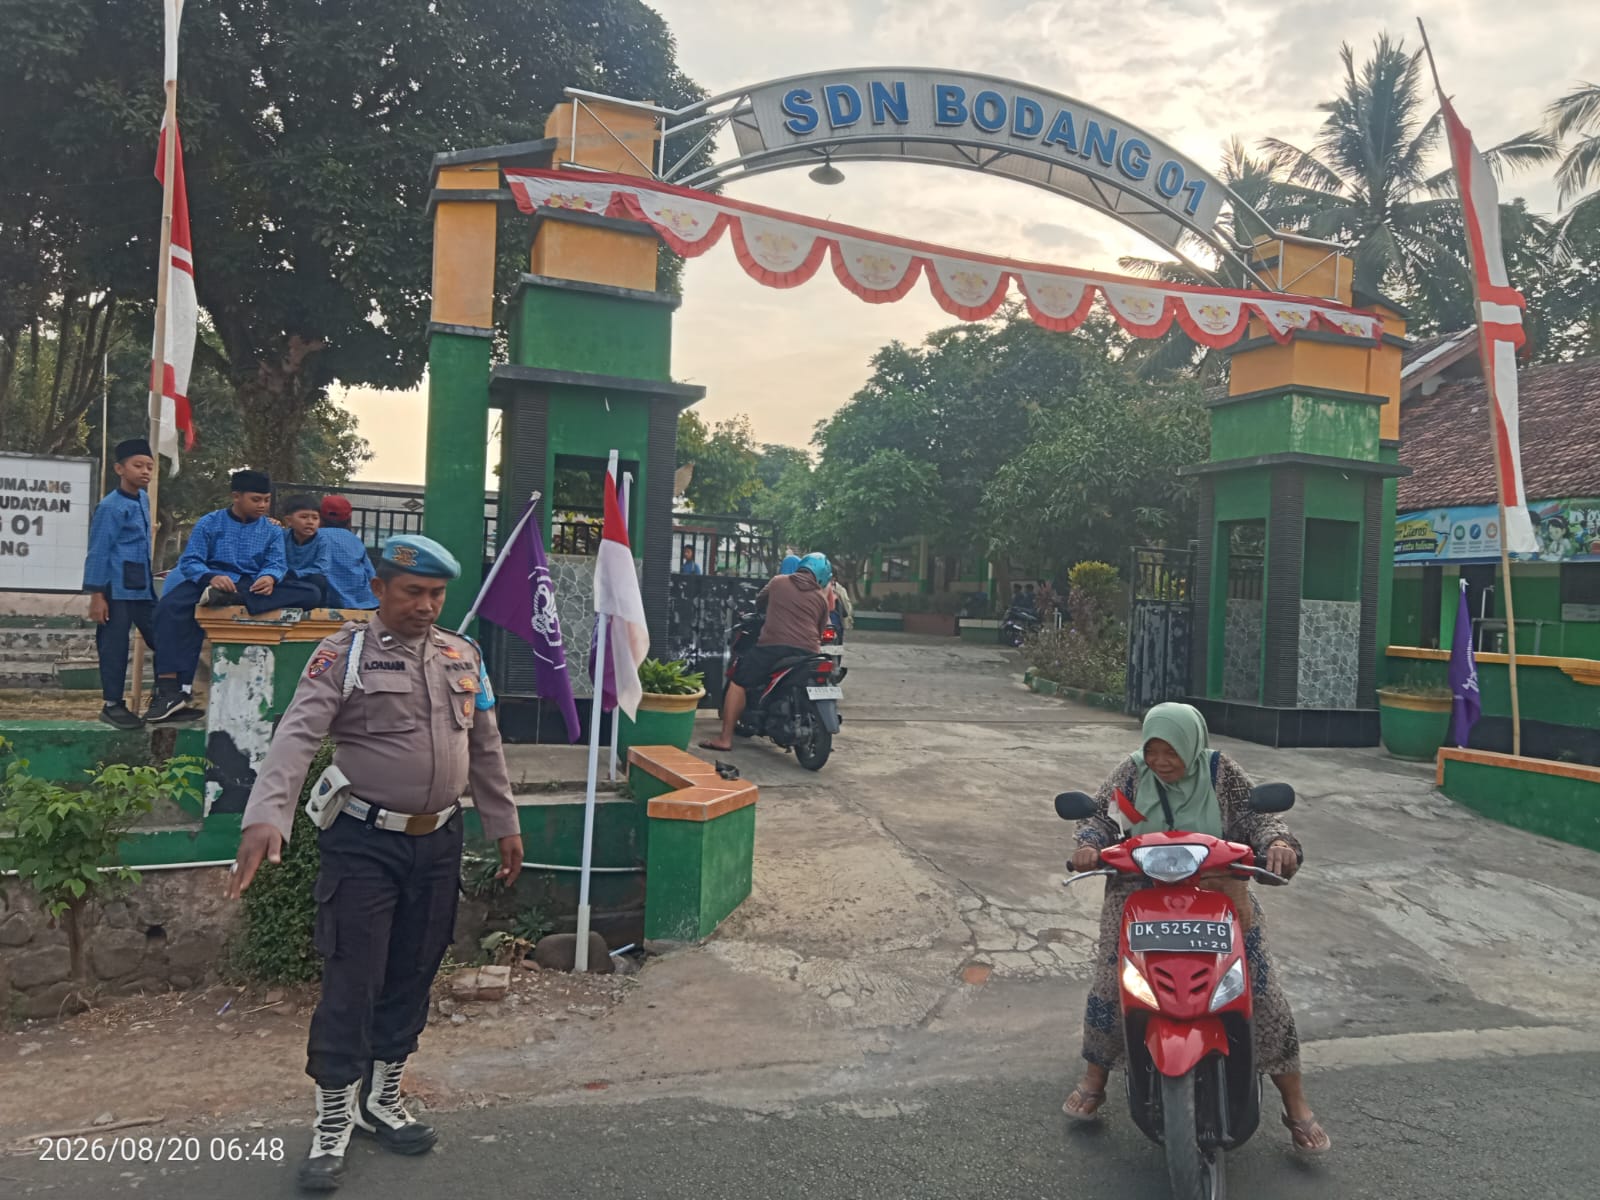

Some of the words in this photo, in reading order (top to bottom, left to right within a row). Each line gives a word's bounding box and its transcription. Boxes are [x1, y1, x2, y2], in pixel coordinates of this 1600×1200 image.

[782, 81, 909, 134] SDN
[934, 84, 1152, 181] BODANG
[1157, 160, 1207, 215] 01
[0, 495, 70, 513] UDAYAAN
[1135, 924, 1154, 936] DK
[1161, 922, 1200, 935] 5254
[1207, 924, 1227, 937] FG
